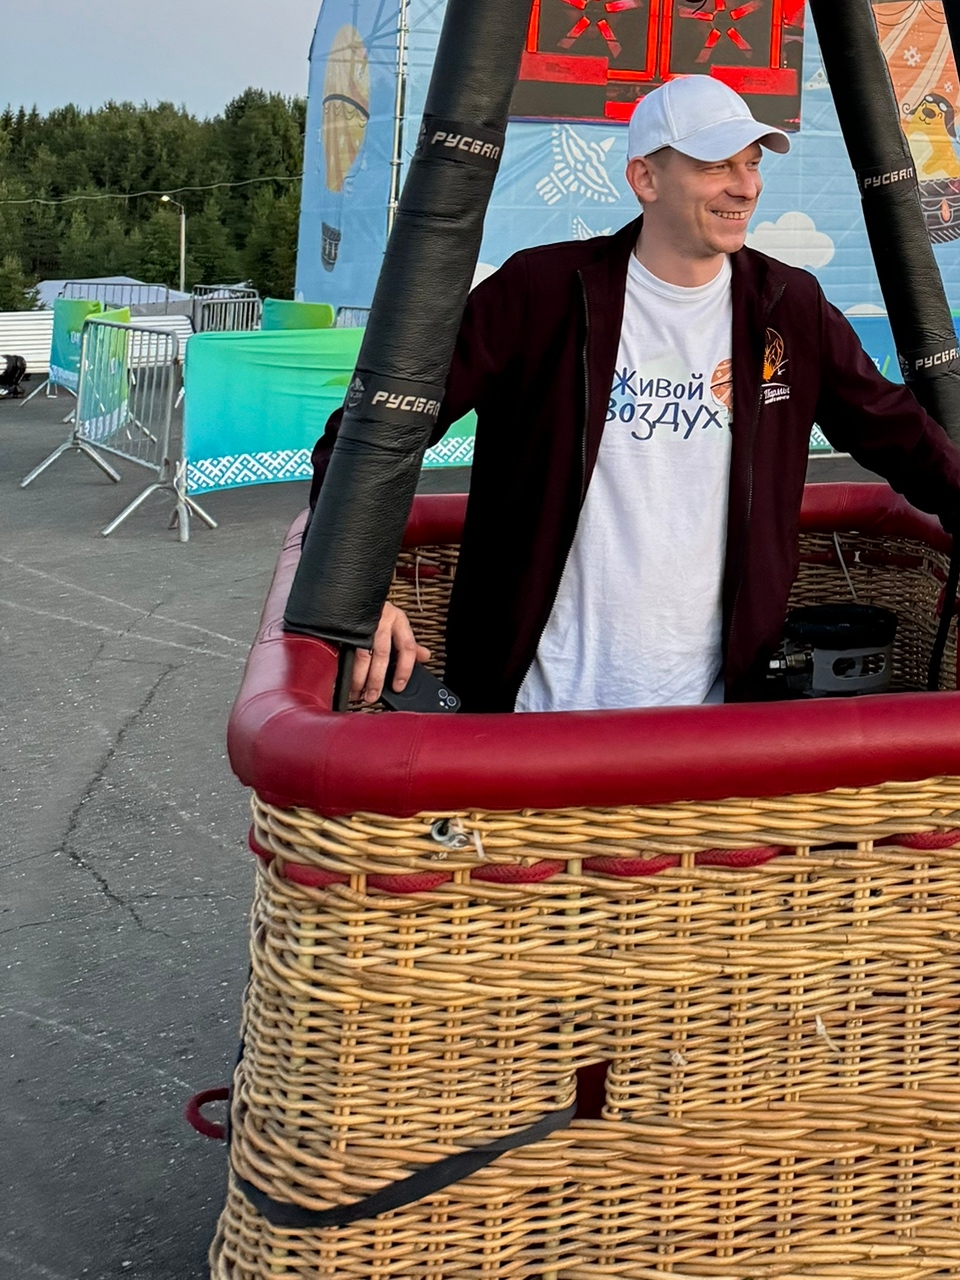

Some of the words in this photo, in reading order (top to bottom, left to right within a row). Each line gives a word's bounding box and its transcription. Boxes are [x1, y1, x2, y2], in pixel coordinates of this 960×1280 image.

[430, 130, 501, 160] РУСБАЛ
[864, 167, 914, 189] РУСБАЛ
[371, 390, 441, 417] РУСБАЛ
